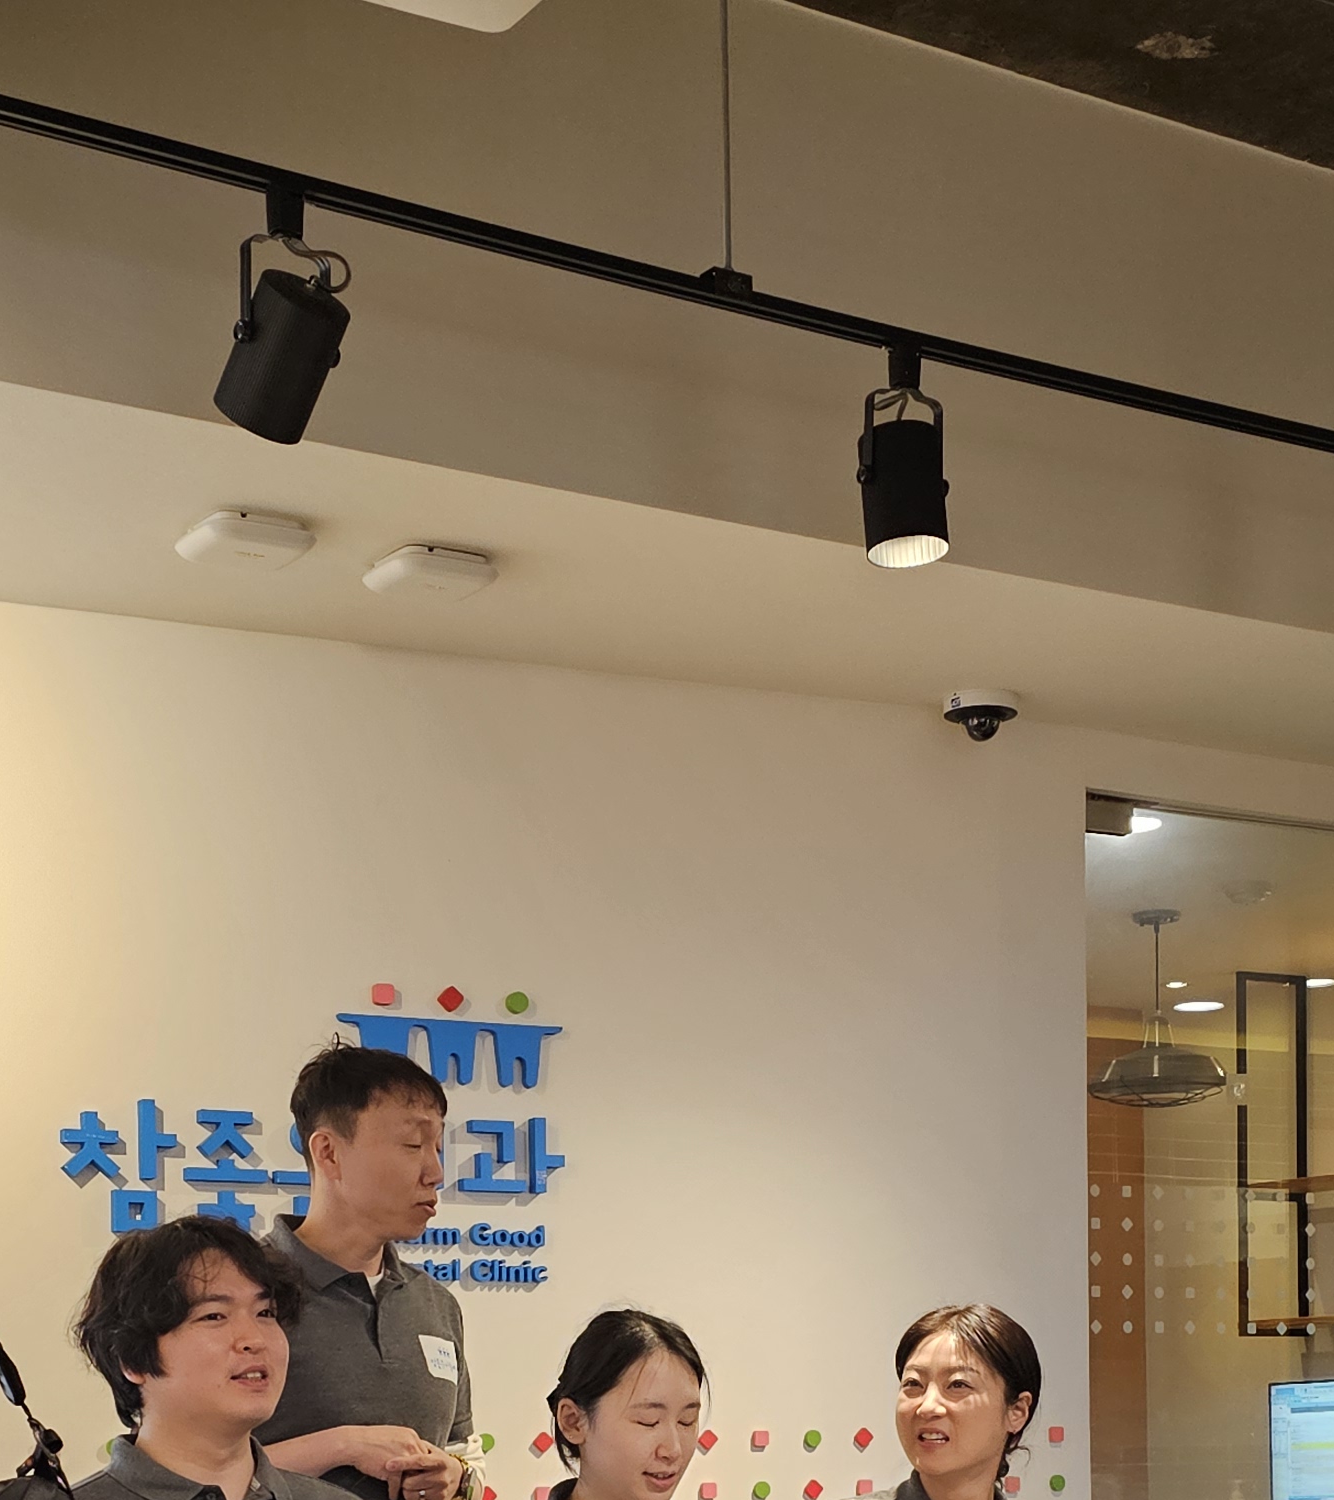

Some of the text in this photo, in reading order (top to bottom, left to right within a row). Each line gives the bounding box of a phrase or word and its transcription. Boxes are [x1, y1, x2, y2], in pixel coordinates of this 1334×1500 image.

[60, 1099, 565, 1233] 참좋과
[469, 1223, 545, 1247] Good
[470, 1259, 548, 1283] Clinic
